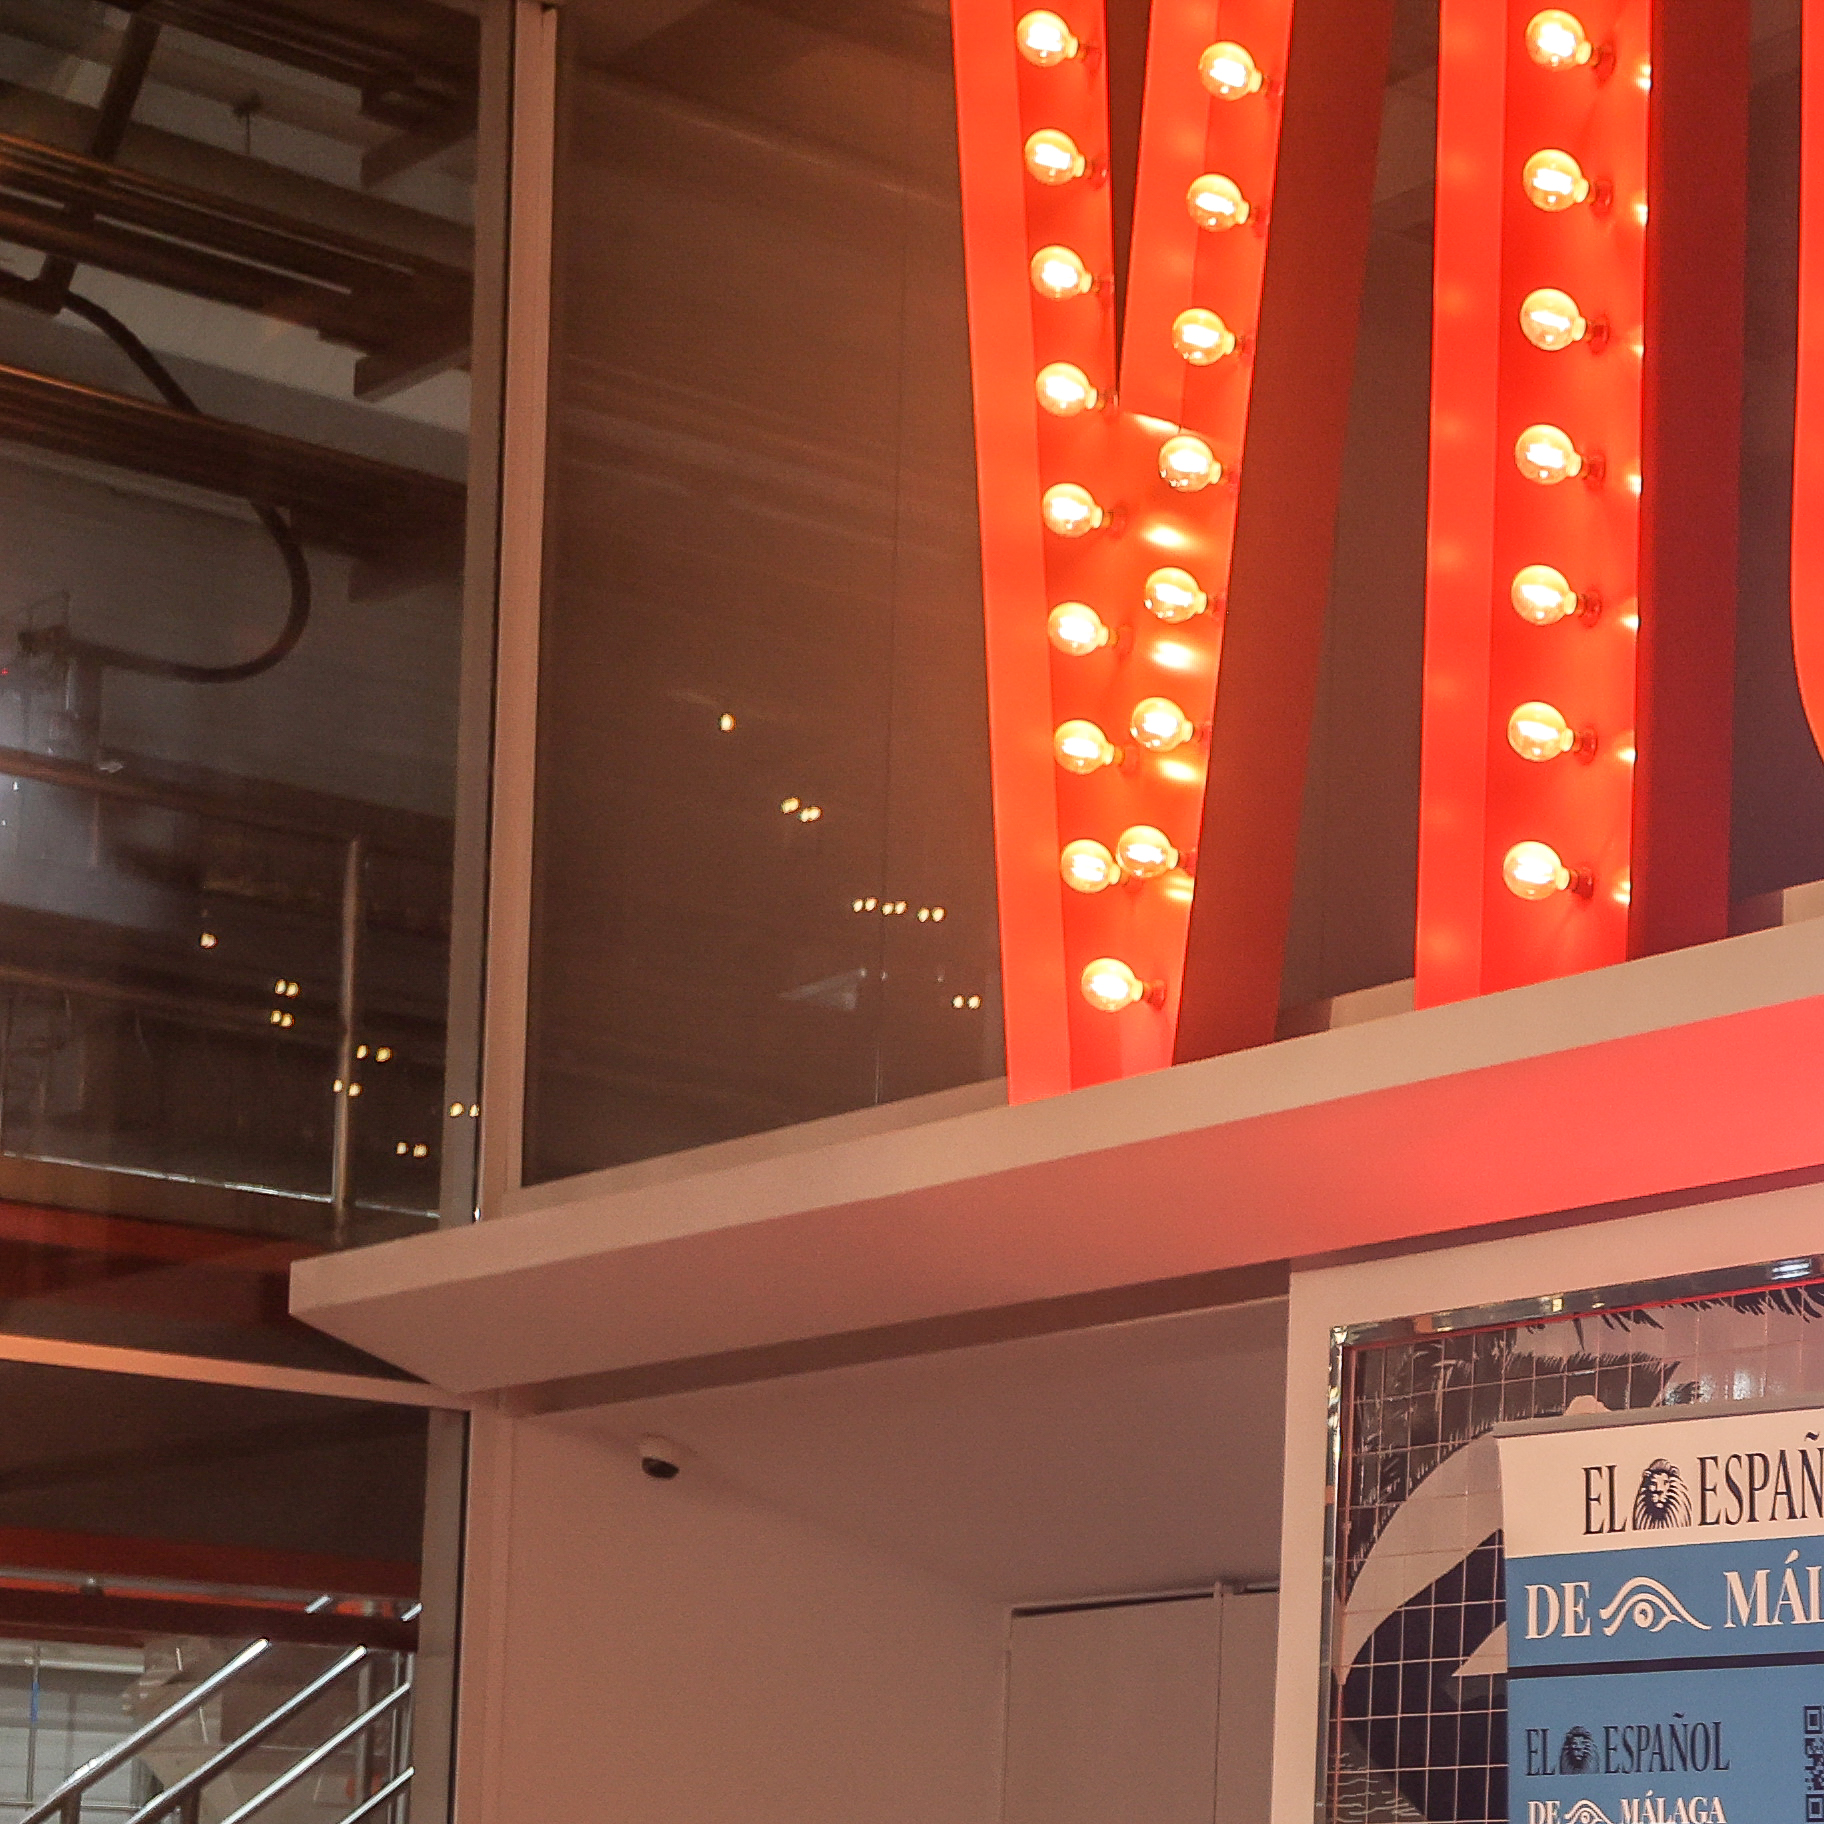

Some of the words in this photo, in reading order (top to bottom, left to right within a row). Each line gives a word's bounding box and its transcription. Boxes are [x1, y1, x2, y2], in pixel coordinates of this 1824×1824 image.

[1582, 1465, 1627, 1535] EL
[1524, 1581, 1591, 1640] DE
[1525, 1728, 1556, 1776] EL
[1603, 1712, 1730, 1775] ESPAÑOL
